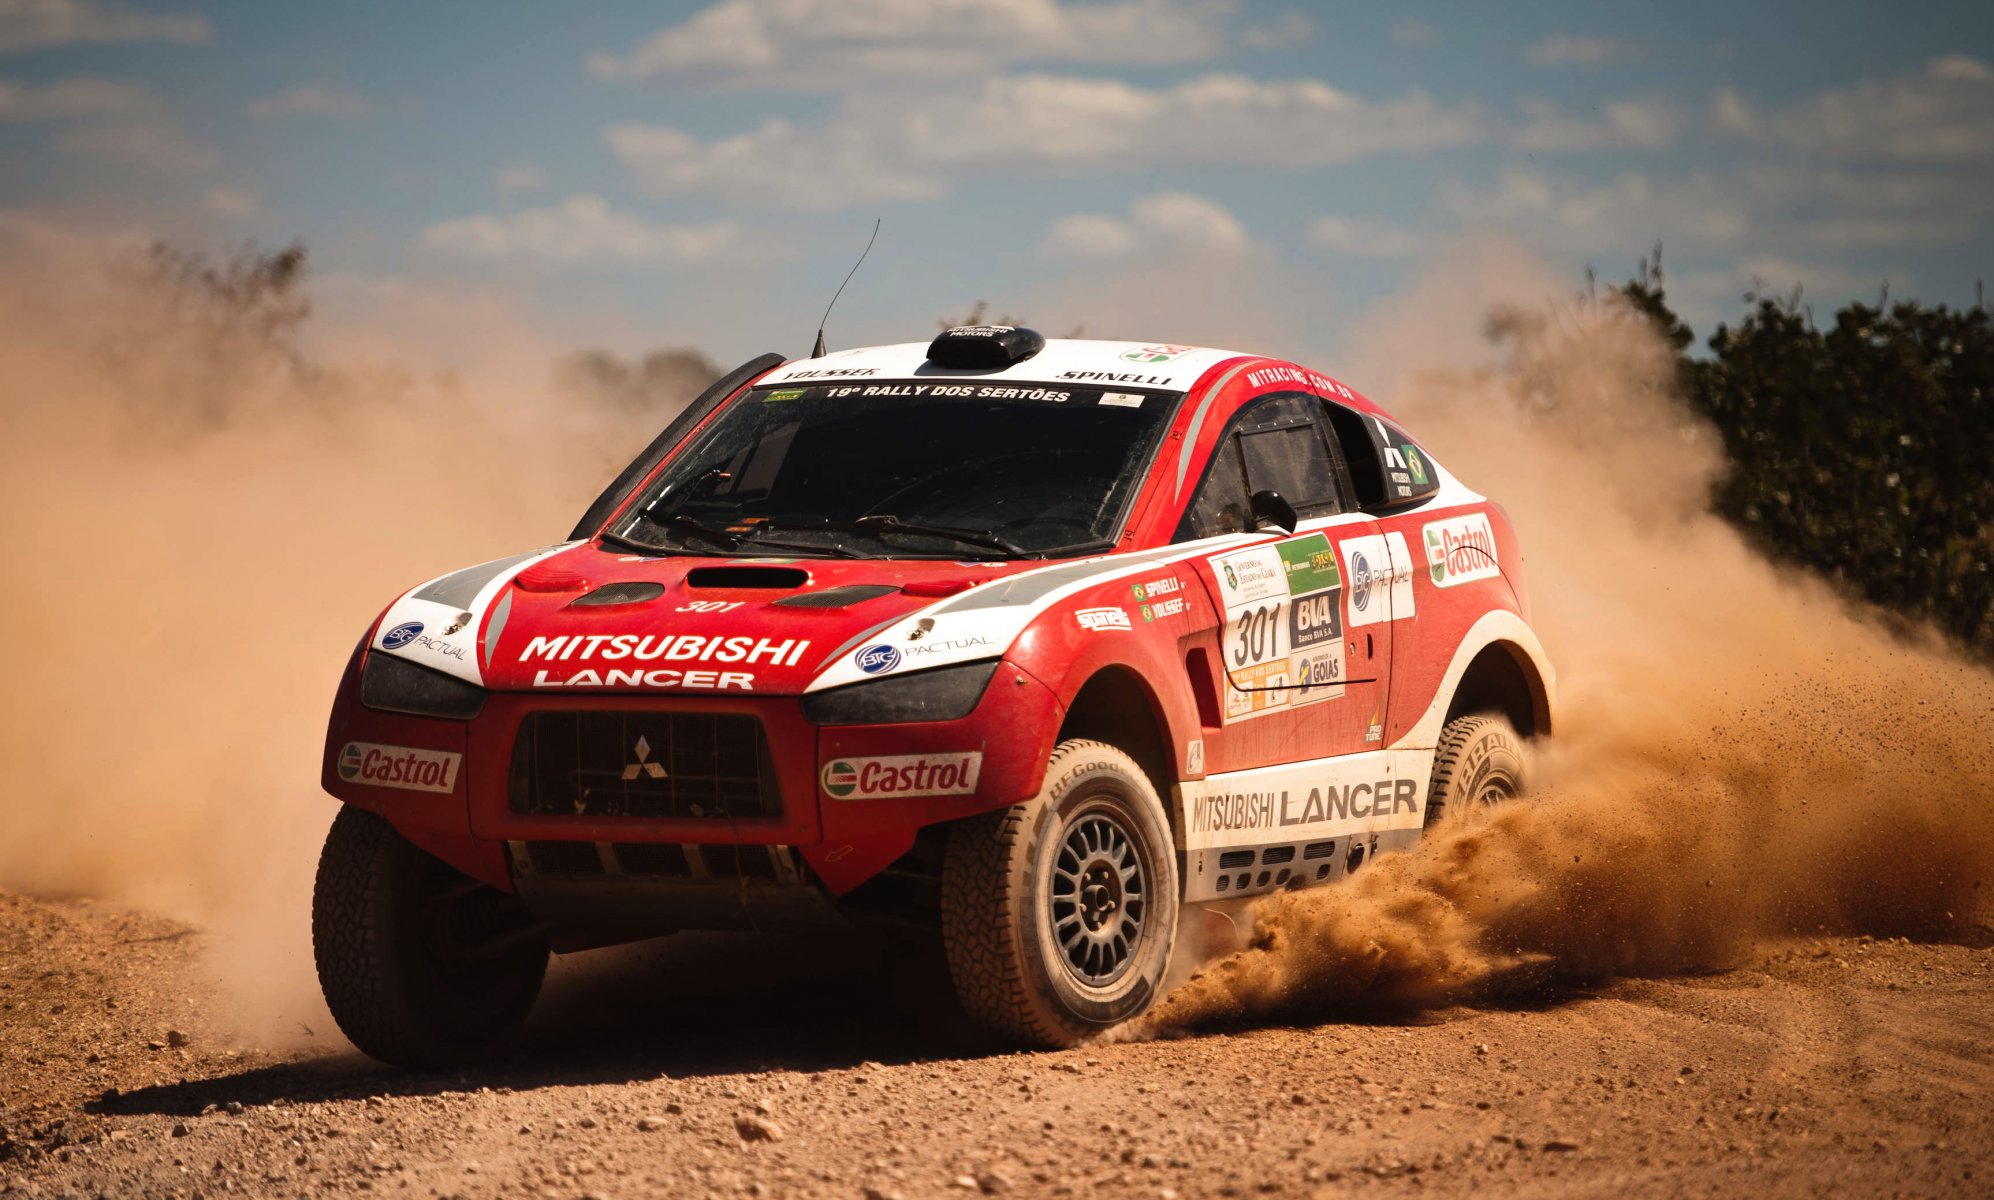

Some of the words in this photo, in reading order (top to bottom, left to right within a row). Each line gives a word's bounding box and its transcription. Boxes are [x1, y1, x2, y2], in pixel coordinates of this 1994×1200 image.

[1056, 371, 1173, 385] SPINELLI
[826, 387, 861, 398] 19º
[862, 386, 928, 396] RALLY
[930, 386, 974, 397] DOS
[977, 387, 1070, 402] SERTÕES
[1442, 522, 1496, 577] Castrol
[1145, 576, 1179, 598] SPINELLI
[1373, 565, 1409, 587] PACTUAL
[675, 600, 745, 613] 301
[1152, 597, 1183, 618] YOUSSEF
[1297, 595, 1332, 631] BVA
[1234, 603, 1281, 667] 301
[1298, 634, 1313, 643] Banco
[1313, 630, 1323, 640] BVA
[414, 635, 468, 661] PACTUAL
[518, 635, 811, 666] MITSUBISHI
[863, 652, 895, 666] BTG
[904, 636, 995, 657] PACTUAL
[533, 669, 755, 690] LANCER
[1365, 733, 1382, 742] TUNE
[1369, 724, 1382, 734] PRO
[361, 748, 452, 787] Castrol
[860, 757, 971, 793] Castrol
[1192, 792, 1275, 833] MITSUBISHI
[1279, 779, 1418, 827] LANCER
